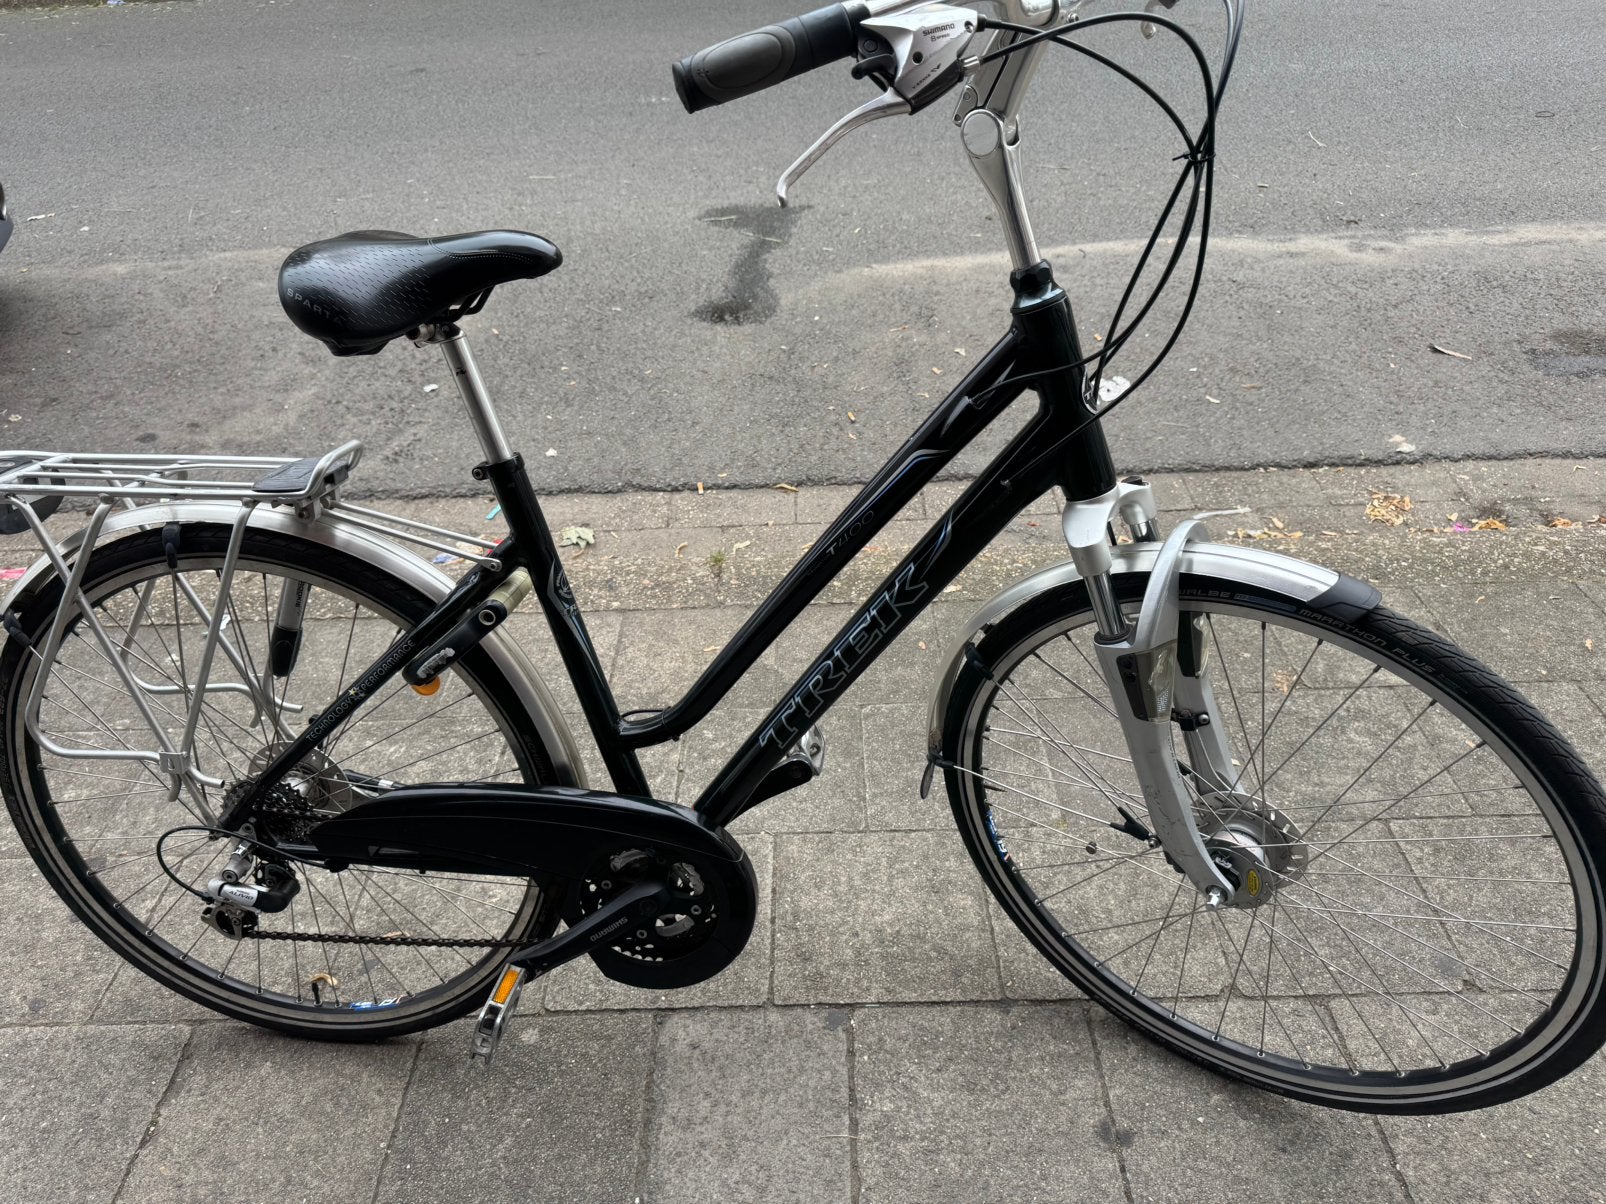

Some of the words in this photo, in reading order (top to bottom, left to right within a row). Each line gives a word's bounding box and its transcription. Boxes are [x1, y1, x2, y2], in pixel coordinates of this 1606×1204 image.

[922, 23, 955, 36] SHIMANO
[286, 287, 345, 326] SPARTA
[826, 510, 874, 555] T400
[759, 561, 929, 749] TREK
[1300, 609, 1388, 647] MARATHON
[1392, 647, 1436, 674] PLUS
[306, 697, 354, 742] TECHNOLOGY
[359, 639, 416, 693] PERFORMANCE
[590, 916, 628, 941] SHIMANO
